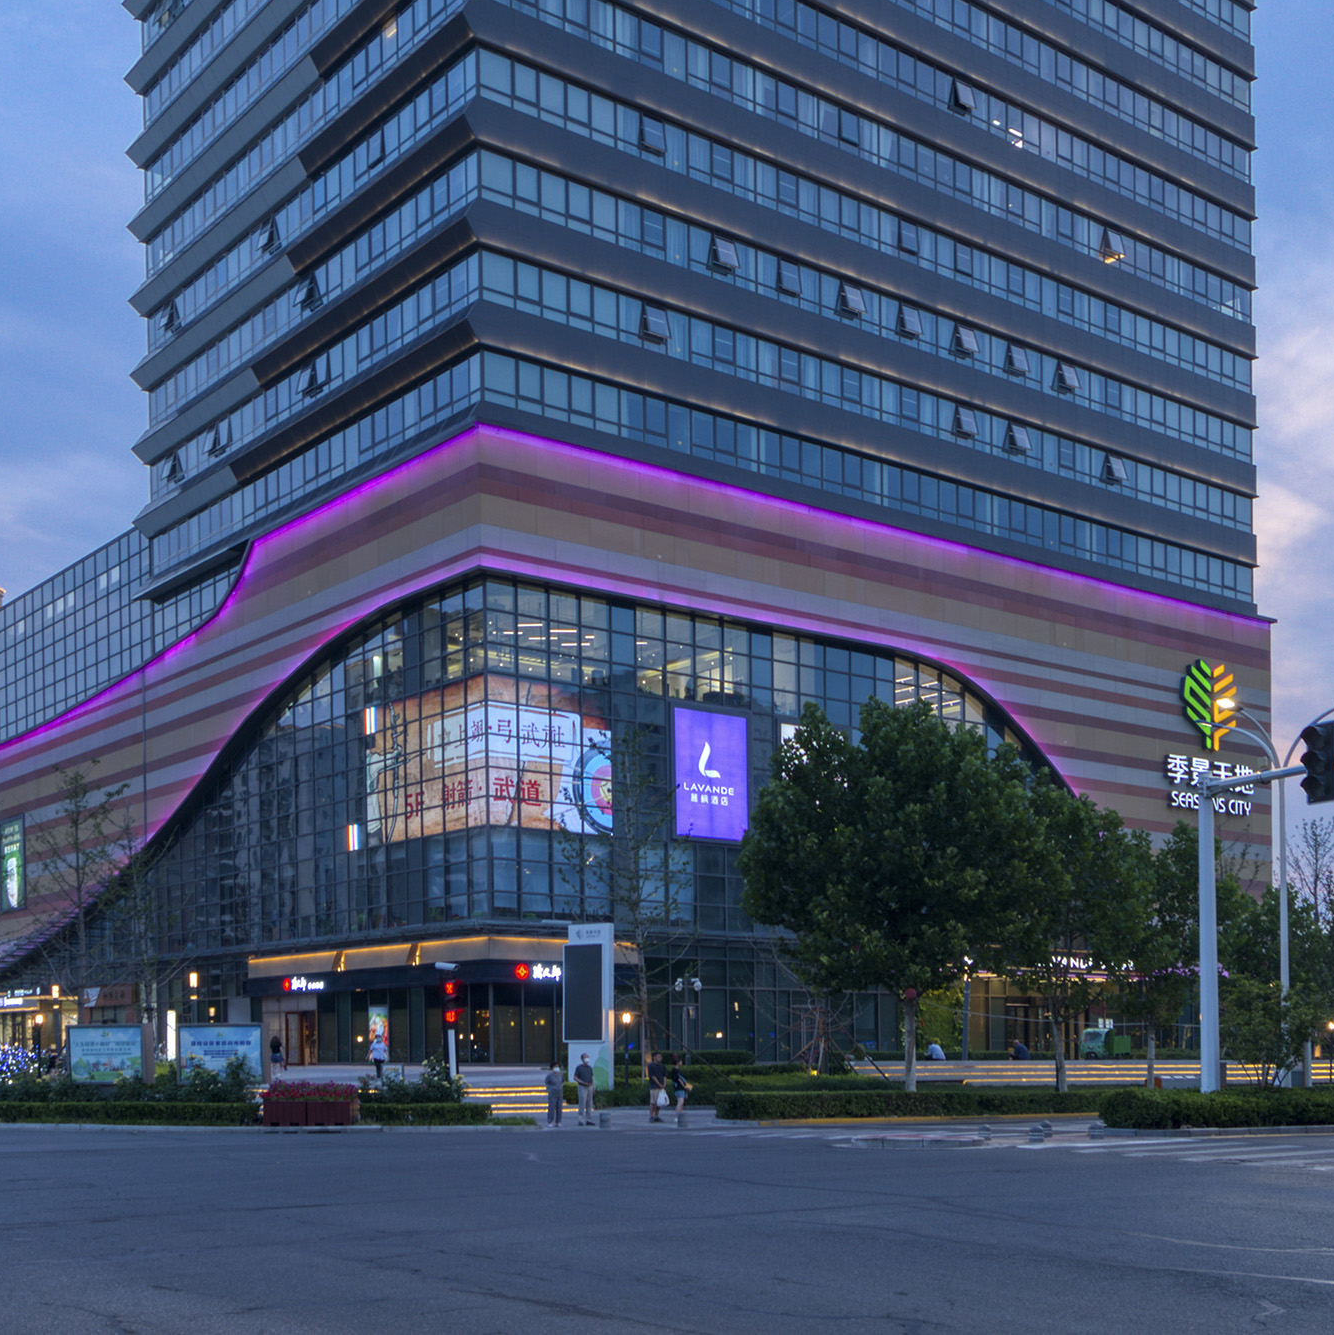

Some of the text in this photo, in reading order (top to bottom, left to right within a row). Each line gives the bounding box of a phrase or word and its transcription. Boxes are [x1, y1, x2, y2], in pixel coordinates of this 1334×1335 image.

[683, 782, 735, 796] LAVANDE
[1171, 791, 1253, 817] SEASNS CITY
